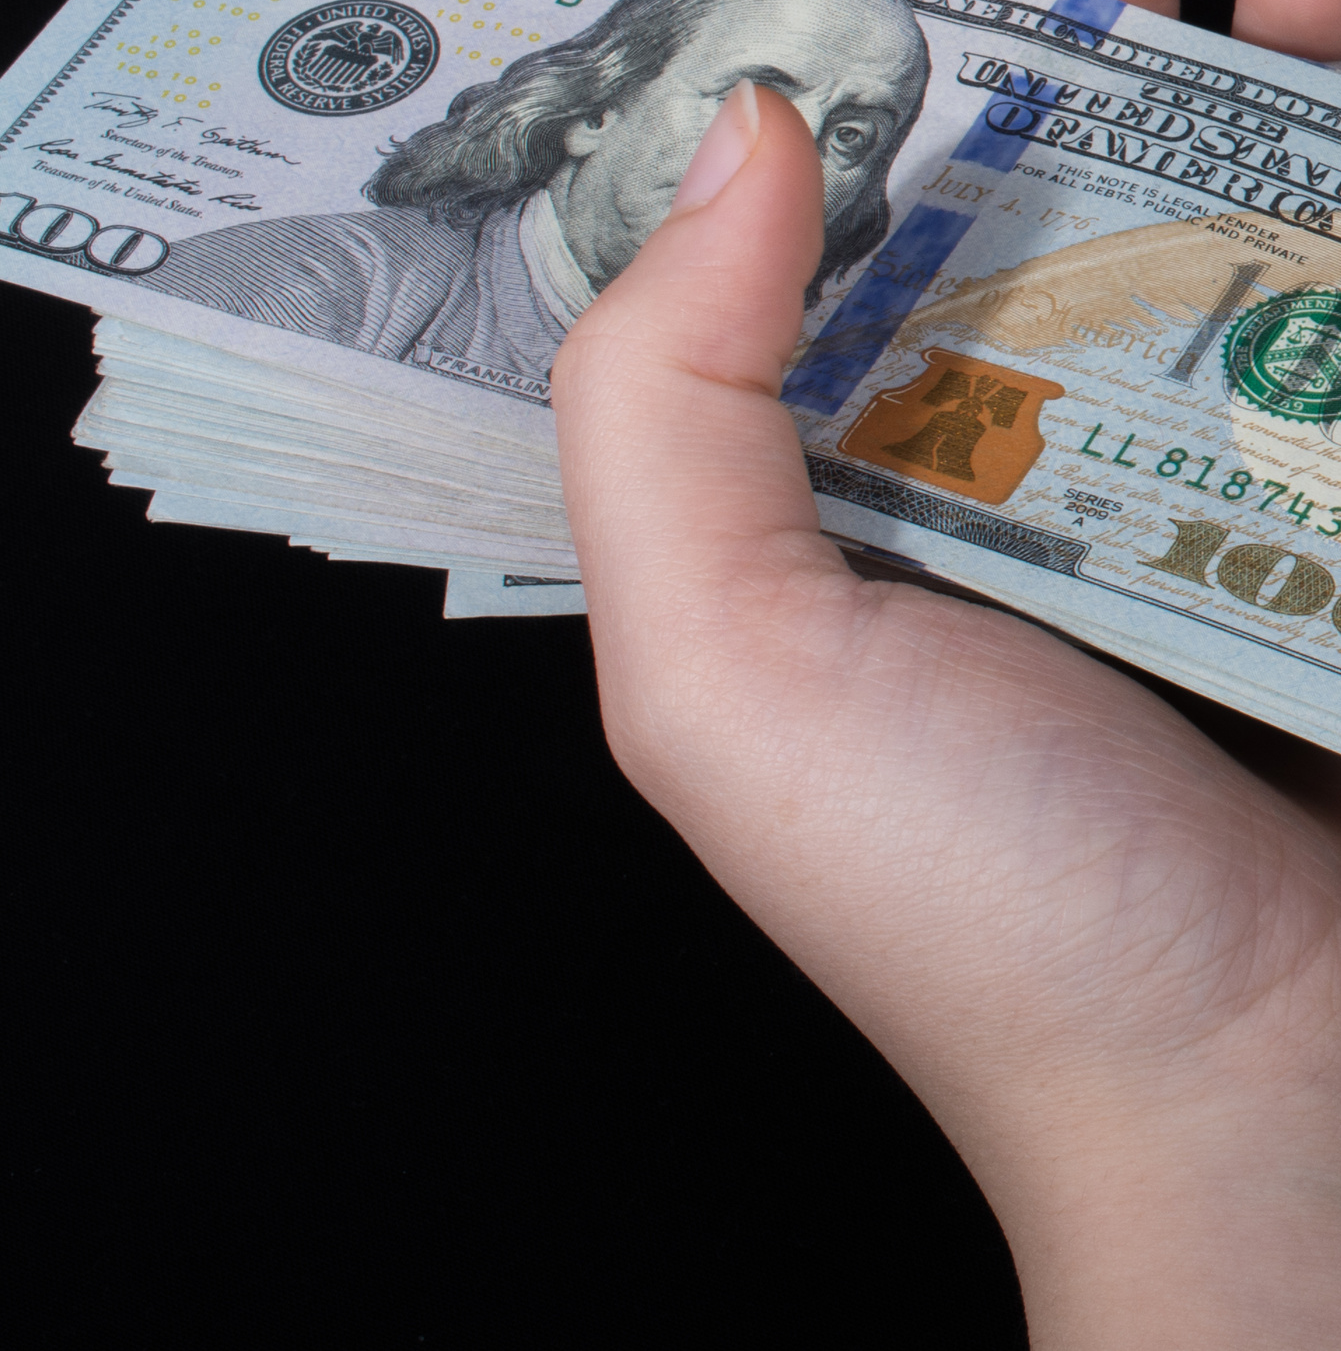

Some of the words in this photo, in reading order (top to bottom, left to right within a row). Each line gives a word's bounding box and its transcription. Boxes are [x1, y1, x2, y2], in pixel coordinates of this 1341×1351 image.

[315, 3, 389, 23] UNITED
[390, 9, 430, 50] STATES
[1003, 5, 1238, 93] HUNDRED
[268, 28, 303, 83] FEDERAL
[277, 81, 351, 110] RESERVE
[363, 62, 425, 107] SYSTEM
[957, 52, 1195, 142] UNITED
[986, 101, 1081, 147] OF
[1140, 82, 1288, 144] THE
[101, 128, 153, 153] Secretary
[155, 145, 173, 158] of
[173, 148, 190, 162] the
[193, 155, 244, 179] Treasury.
[32, 159, 88, 183] Treasurer
[90, 178, 103, 190] of
[103, 181, 122, 194] the
[124, 186, 164, 207] United
[165, 199, 203, 219] States.
[1057, 163, 1092, 180] THIS
[1096, 174, 1140, 193] NOTE
[1142, 187, 1159, 198] IS
[1161, 193, 1215, 218] LEGAL
[1216, 212, 1280, 242] TENDER
[1013, 162, 1048, 179] FOR
[1048, 172, 1078, 189] ALL
[1142, 199, 1203, 227] PUBLIC
[1204, 216, 1242, 239] AND
[1243, 234, 1310, 266] PRIVATE
[1243, 299, 1338, 347] DEPARTMENT
[437, 354, 551, 396] FRANKLIN
[1080, 422, 1136, 468] LL
[1063, 487, 1124, 513] SERIES
[1064, 501, 1109, 521] 2009
[1071, 516, 1084, 528] A
